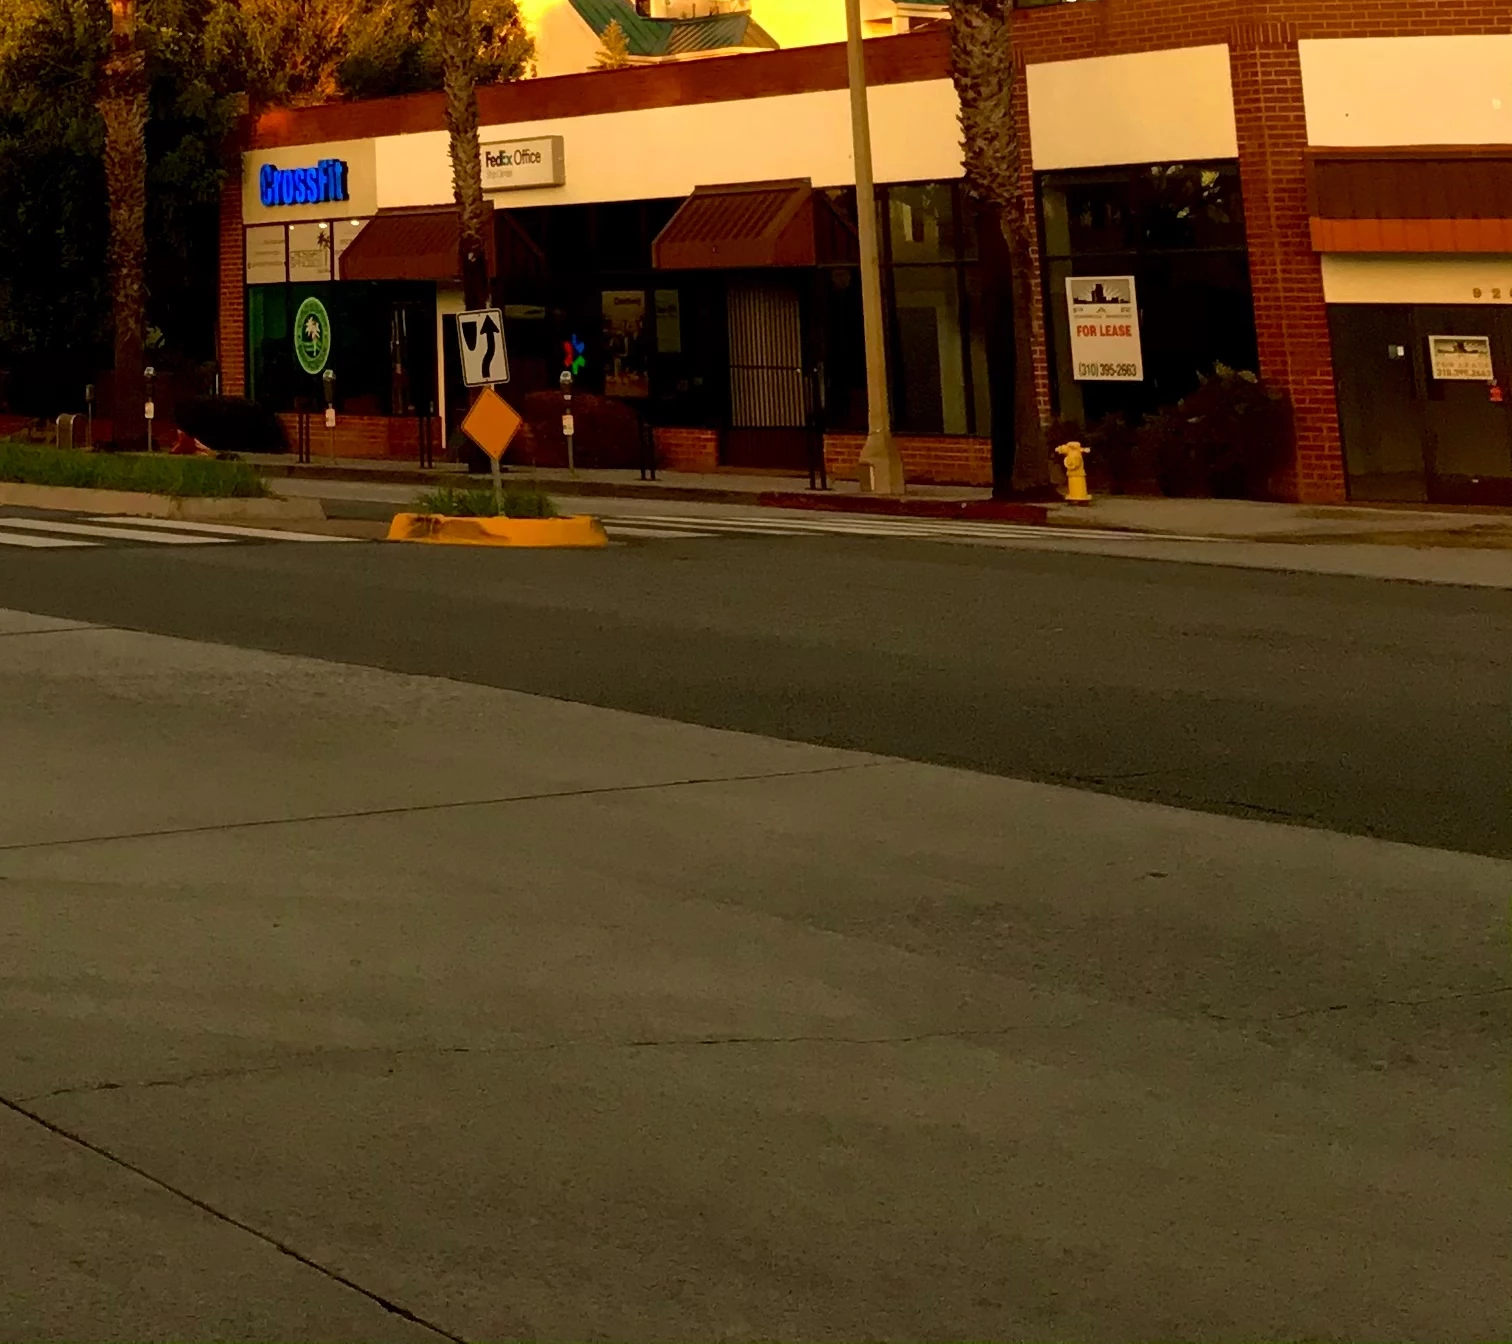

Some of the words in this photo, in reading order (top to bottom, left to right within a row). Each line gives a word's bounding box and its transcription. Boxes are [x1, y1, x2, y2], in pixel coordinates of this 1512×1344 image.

[485, 150, 513, 168] FedEx
[514, 149, 541, 165] Office
[260, 159, 348, 207] CrossFit
[1076, 324, 1097, 337] FOR
[1099, 324, 1132, 337] LEASE
[1078, 361, 1099, 377] (310)
